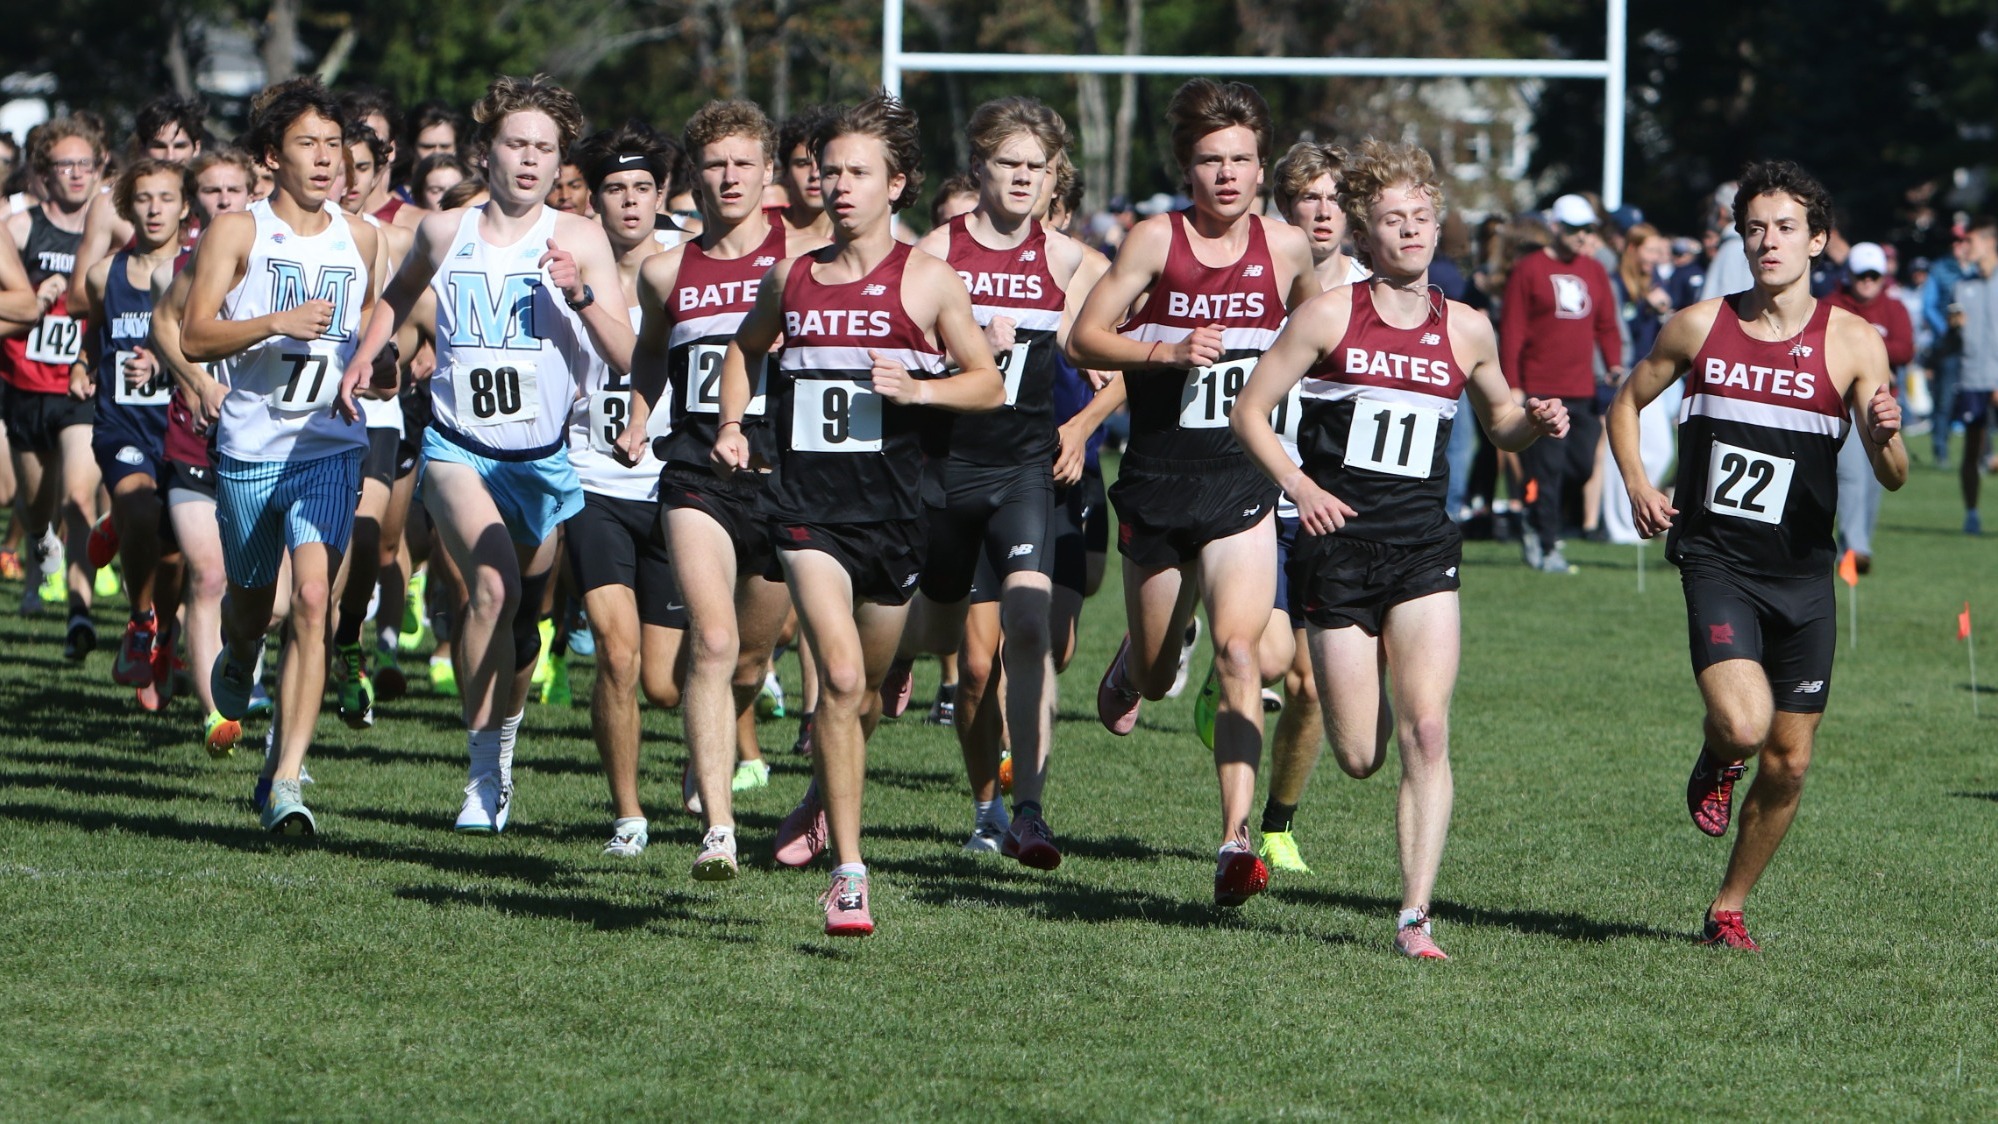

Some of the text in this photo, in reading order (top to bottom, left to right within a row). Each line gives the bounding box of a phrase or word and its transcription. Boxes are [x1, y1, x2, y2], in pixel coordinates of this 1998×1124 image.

[267, 258, 356, 342] M
[679, 279, 761, 312] BATE
[955, 271, 1043, 300] BATES
[1168, 291, 1264, 319] BATES
[449, 271, 542, 351] M
[785, 310, 891, 337] BATES
[33, 321, 78, 356] 142
[281, 353, 329, 403] 77
[470, 366, 522, 419] 80
[1345, 348, 1451, 387] BATES
[1704, 357, 1815, 400] BATES
[822, 387, 848, 444] 9
[1202, 366, 1245, 421] 19
[1371, 409, 1417, 467] 11
[1713, 452, 1775, 514] 22
